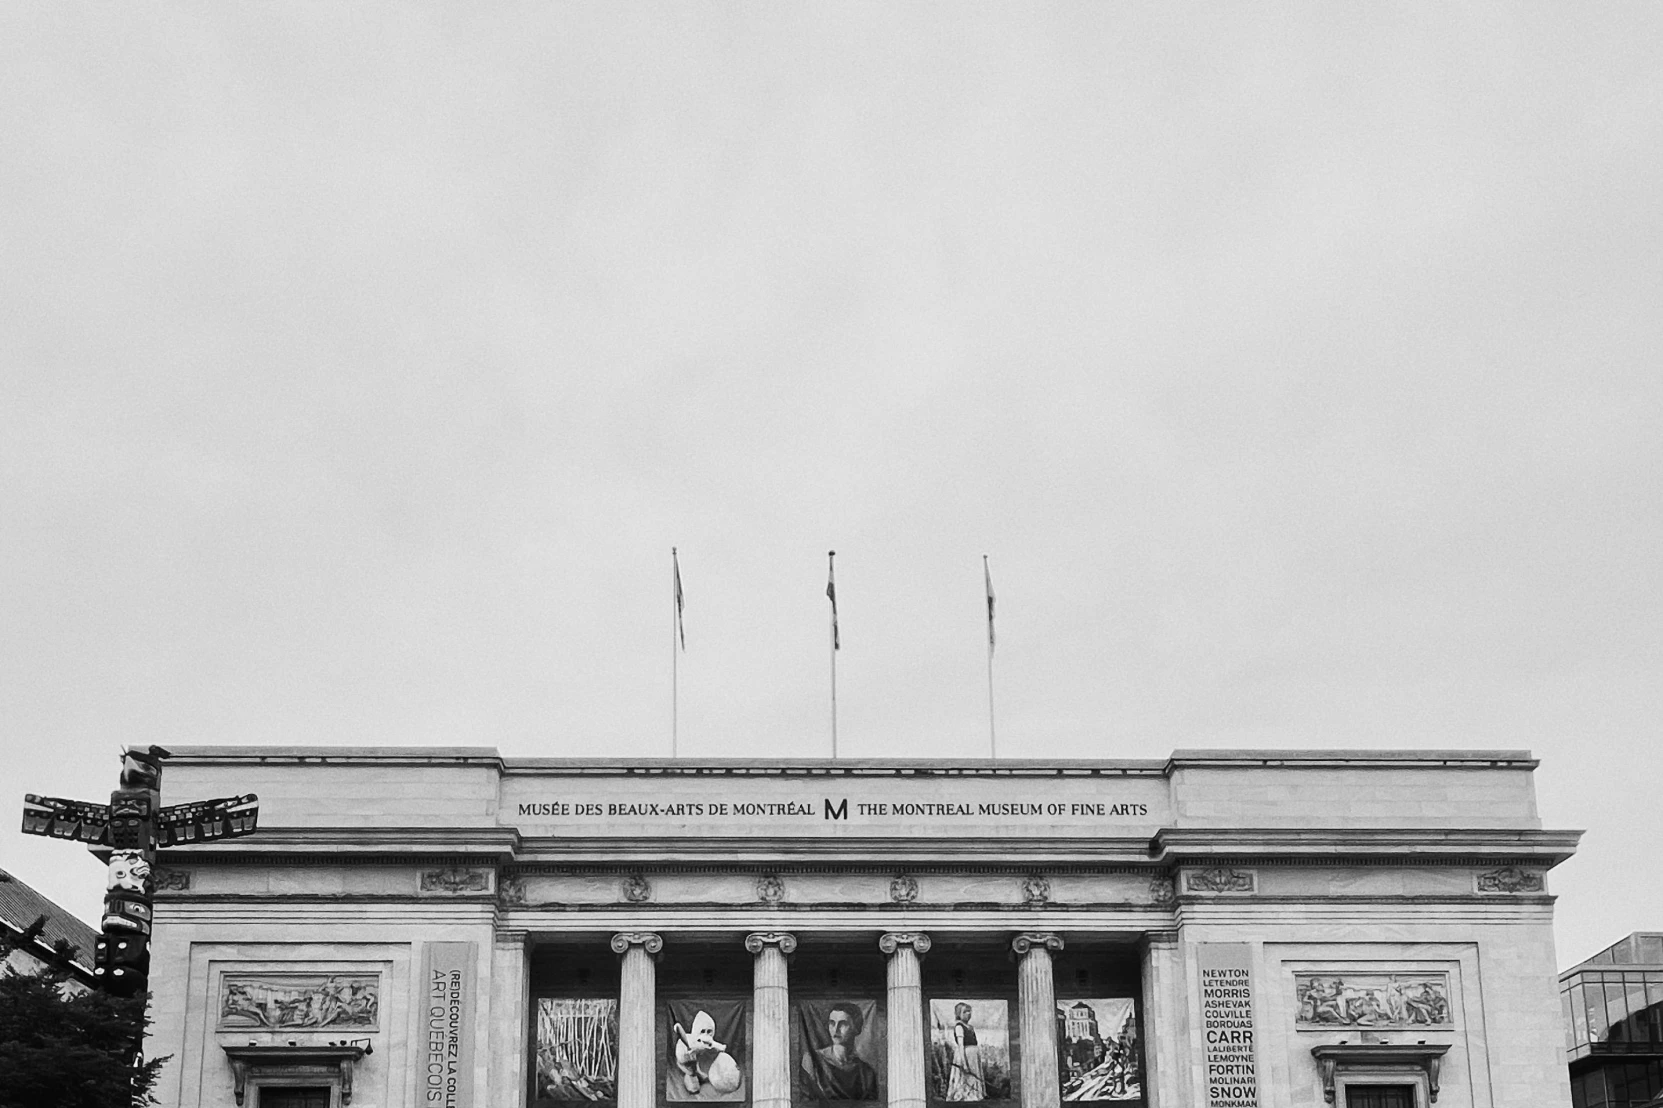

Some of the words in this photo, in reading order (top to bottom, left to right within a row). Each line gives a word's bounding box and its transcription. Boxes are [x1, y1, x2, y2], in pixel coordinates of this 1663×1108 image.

[518, 801, 570, 816] MUSÉE
[575, 804, 603, 815] DES
[608, 804, 704, 816] BEAUX-ARTS
[709, 804, 728, 815] DE
[733, 801, 816, 816] MONTRÉAL
[825, 798, 848, 820] M
[857, 804, 888, 815] THE
[892, 804, 975, 816] MONTREAL
[979, 804, 1043, 816] MUSEUM
[1047, 804, 1067, 816] OF
[1072, 804, 1106, 815] FINE
[1109, 804, 1148, 816] ARTS
[1203, 969, 1249, 977] NEWTON
[432, 969, 446, 1001] ART
[1204, 989, 1250, 998] MORRIS
[1205, 1000, 1251, 1008] ASHEVAK
[1205, 1010, 1251, 1018] COLVILLE
[1206, 1020, 1253, 1028] BORDUAS
[1206, 1030, 1253, 1044] CARR
[447, 1061, 457, 1074] LA
[1209, 1064, 1255, 1075] FORTIN
[1210, 1086, 1256, 1099] SNOW
